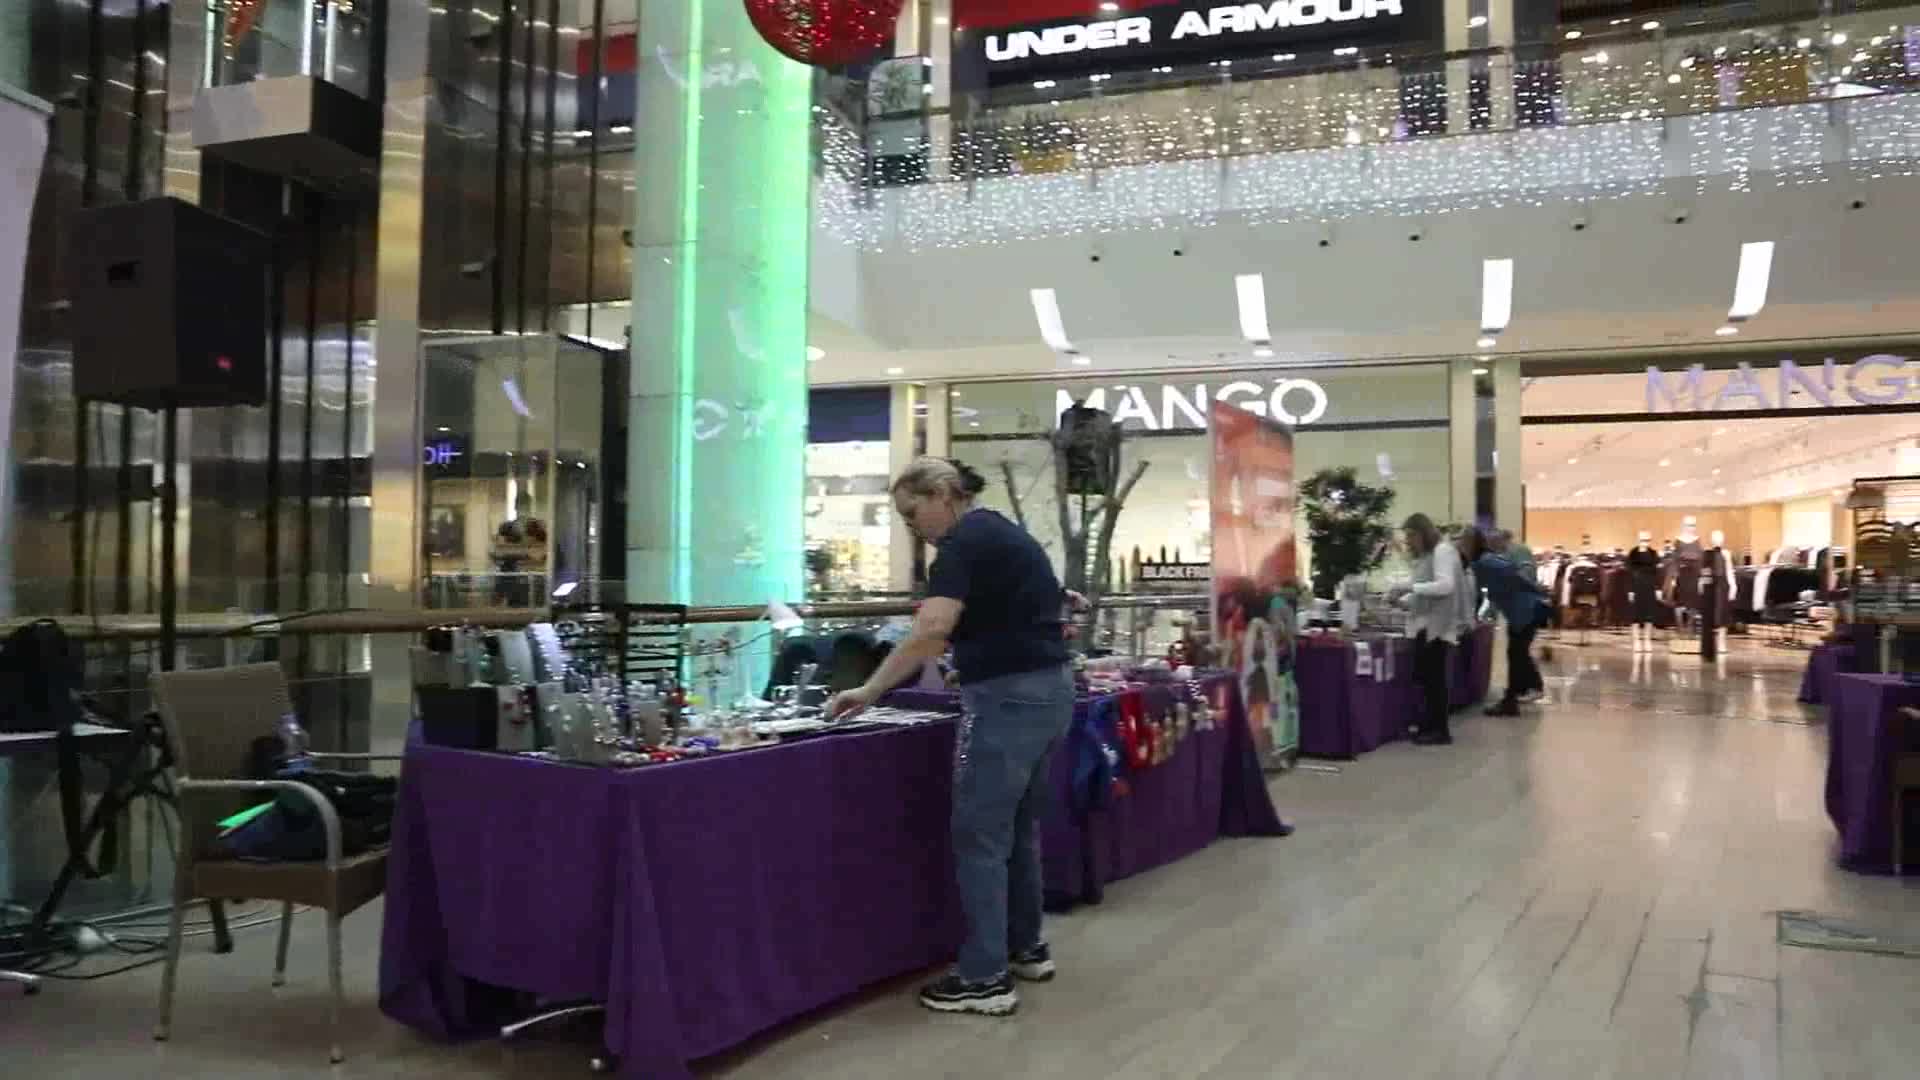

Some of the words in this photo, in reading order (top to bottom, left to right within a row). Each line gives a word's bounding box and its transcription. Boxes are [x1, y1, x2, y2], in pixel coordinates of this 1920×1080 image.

[985, 17, 1151, 61] UNDER
[1171, 0, 1403, 39] ARMOUR
[1055, 378, 1328, 431] MANGO
[1646, 354, 1920, 413] MANG
[1187, 565, 1211, 579] FRI
